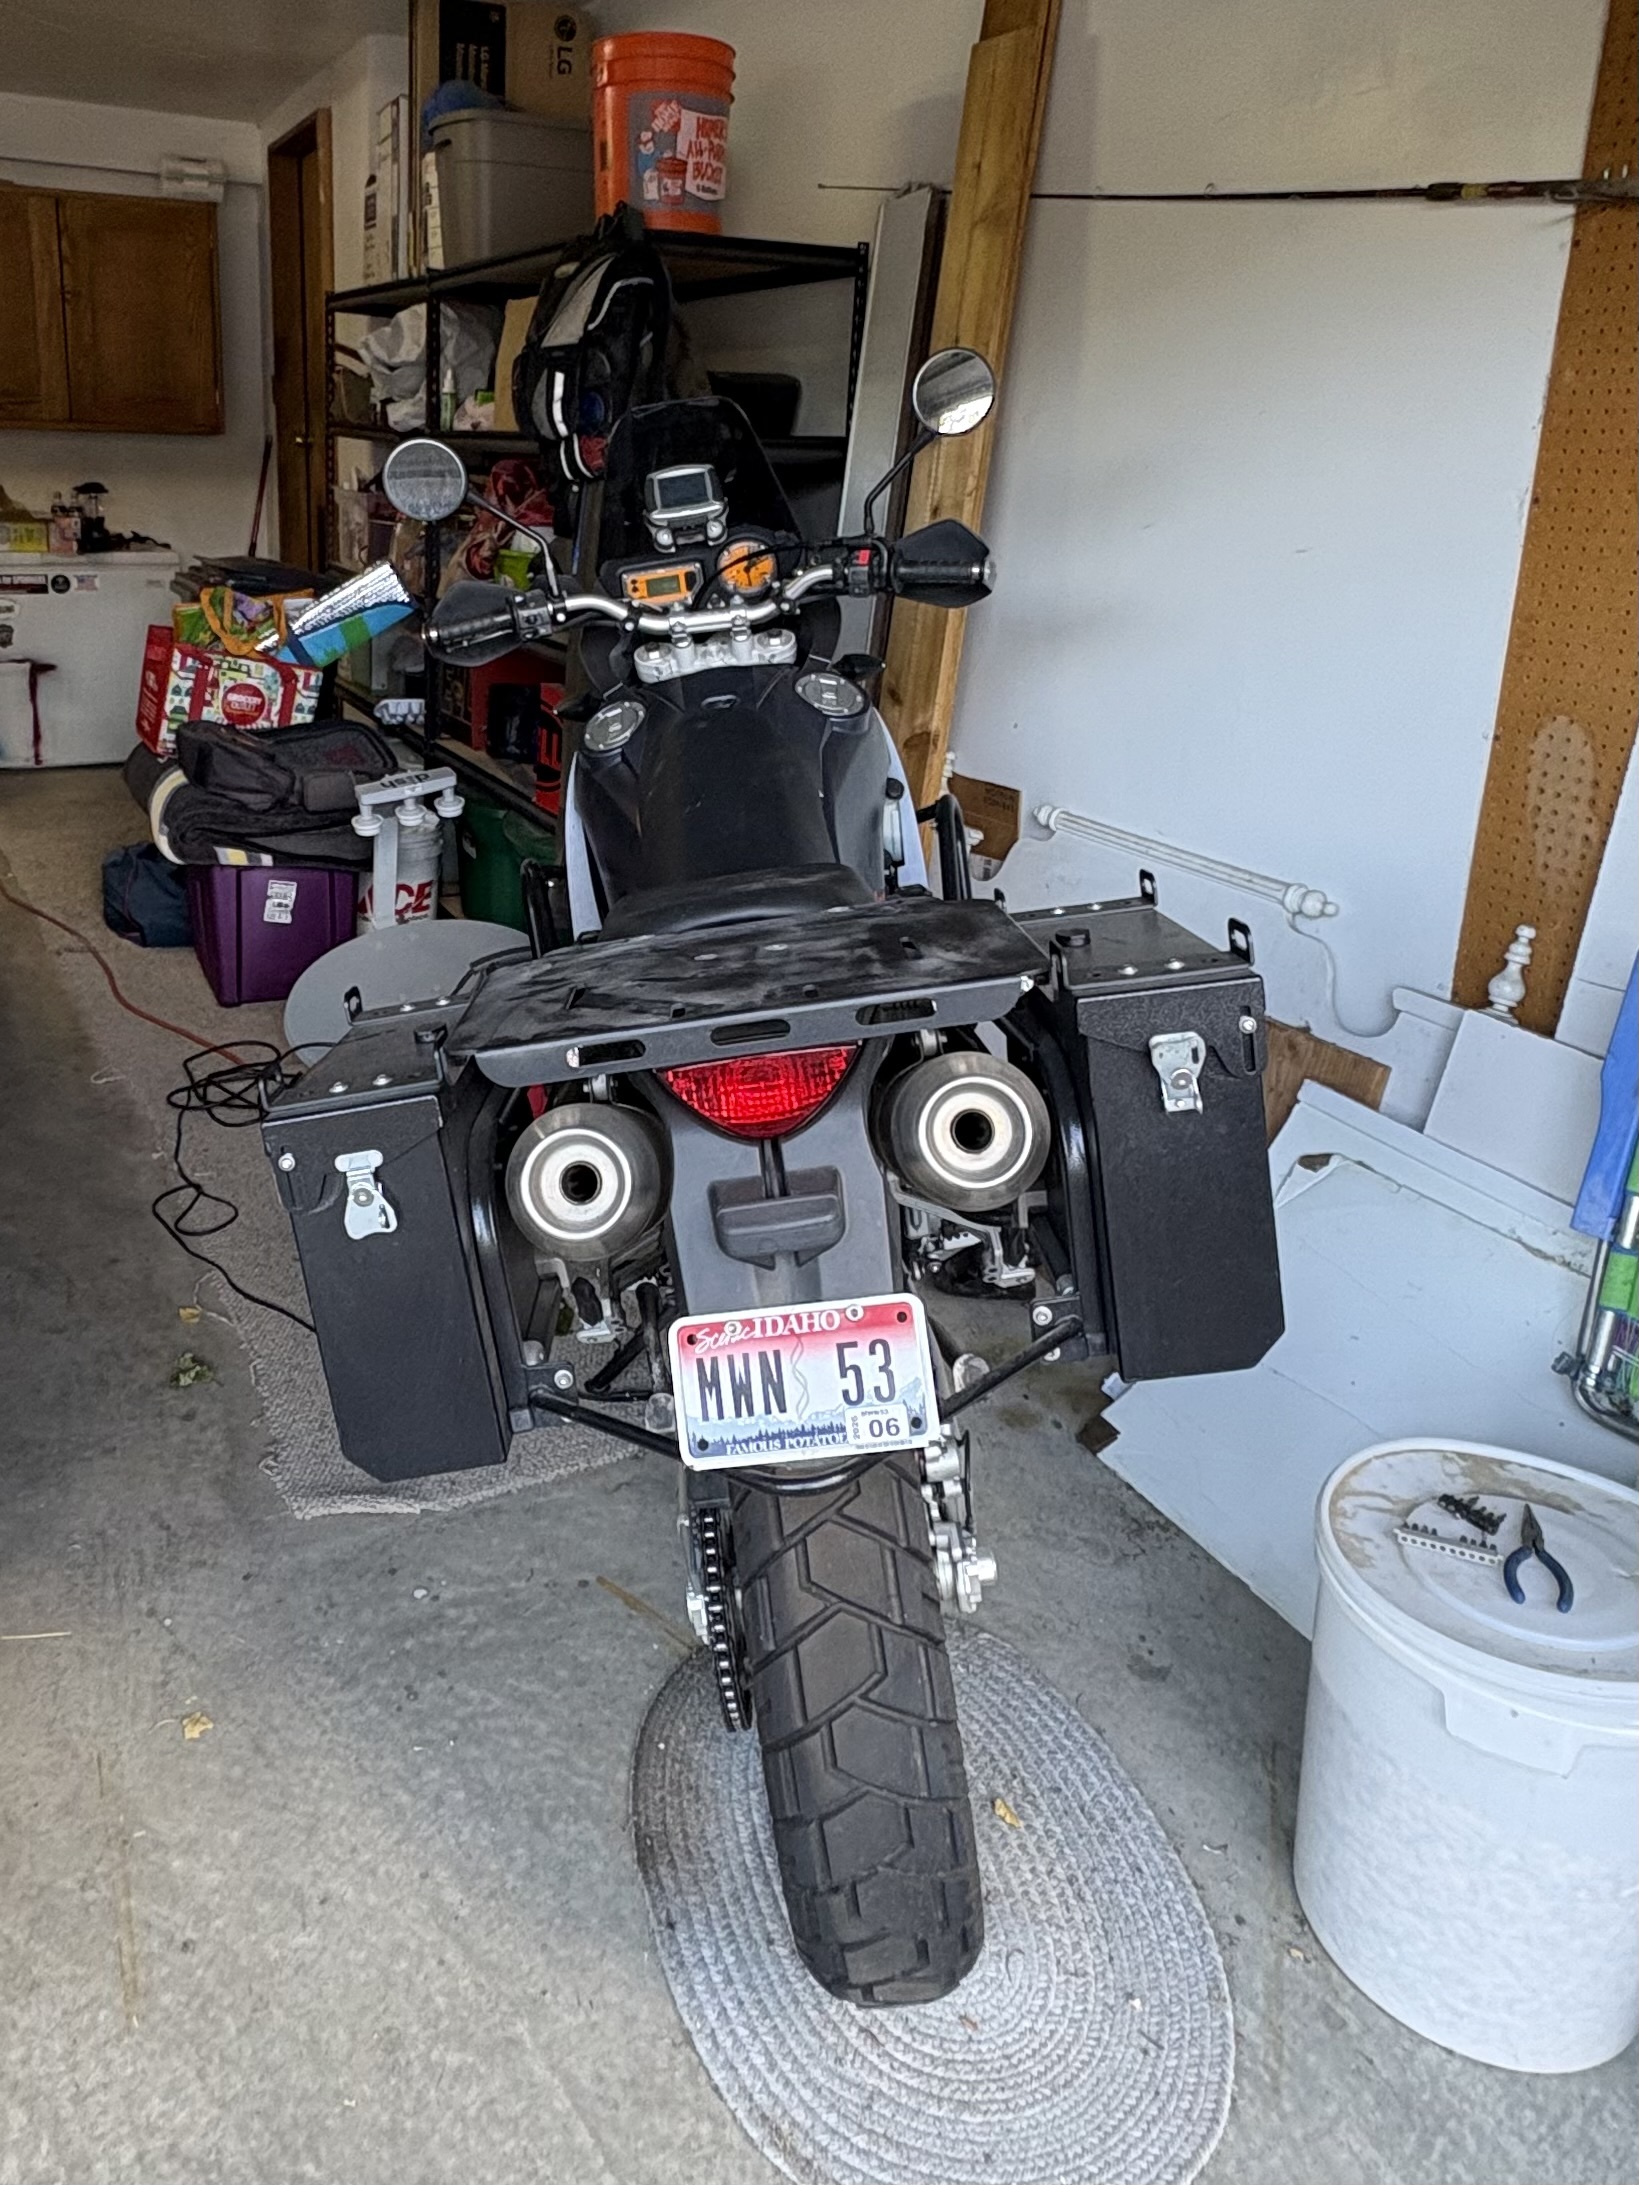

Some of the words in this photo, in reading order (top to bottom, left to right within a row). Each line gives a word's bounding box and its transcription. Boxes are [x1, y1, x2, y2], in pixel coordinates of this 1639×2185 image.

[557, 46, 573, 75] LG
[753, 1310, 841, 1338] IDAHO
[696, 1350, 787, 1422] MWN
[836, 1338, 896, 1407] 53
[868, 1417, 901, 1438] 06
[726, 1438, 782, 1456] FAMOUS
